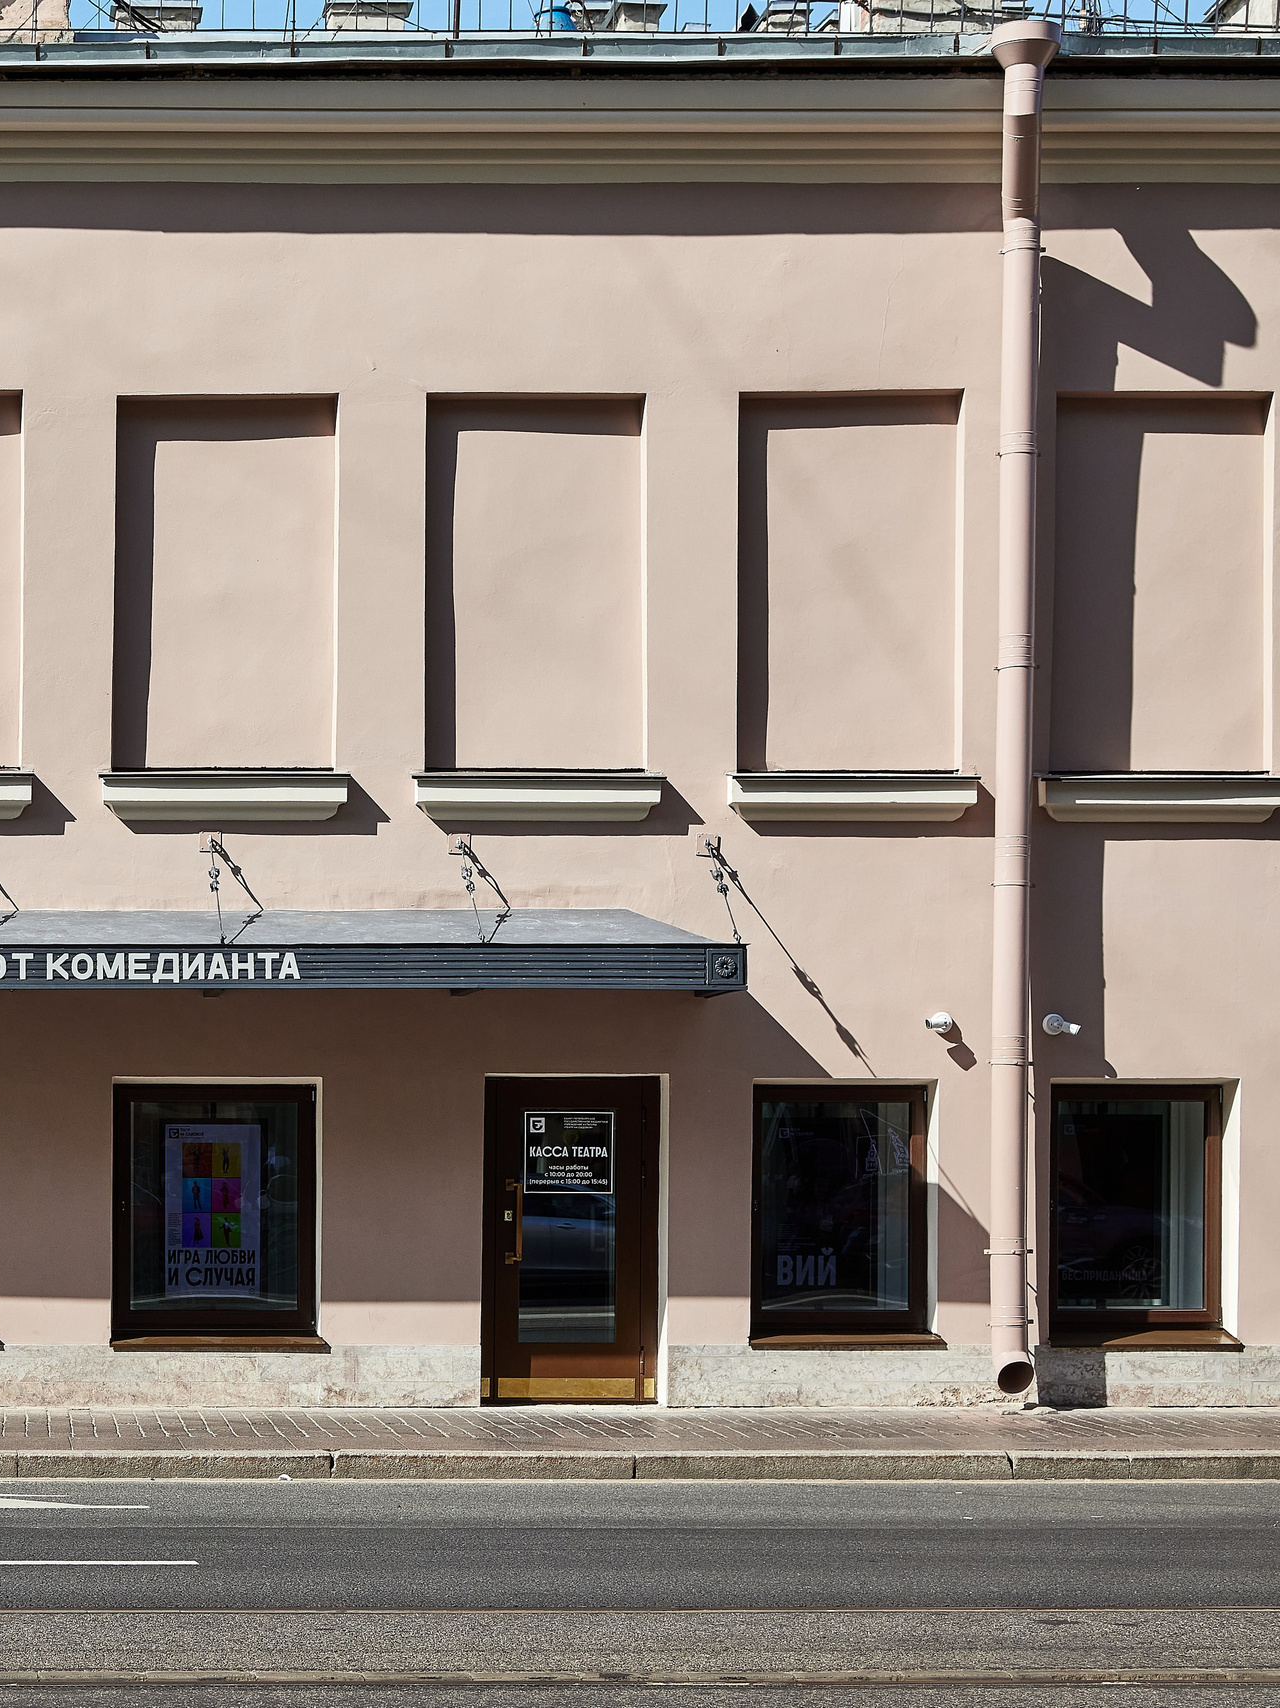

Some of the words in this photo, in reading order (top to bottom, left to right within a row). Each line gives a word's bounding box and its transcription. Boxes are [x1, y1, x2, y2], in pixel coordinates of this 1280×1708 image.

[46, 952, 301, 984] КОМЕДИАНТА
[529, 1146, 569, 1158] КАССА
[571, 1146, 608, 1158] ТЕАТРА
[565, 1163, 589, 1171] работы
[529, 1178, 560, 1186] (перерыв
[168, 1249, 201, 1265] ИГРА
[204, 1249, 256, 1265] ЛЮБВИ
[776, 1247, 837, 1287] ВИЙ
[168, 1267, 179, 1286] И
[185, 1266, 256, 1287] СЛУЧАЯ
